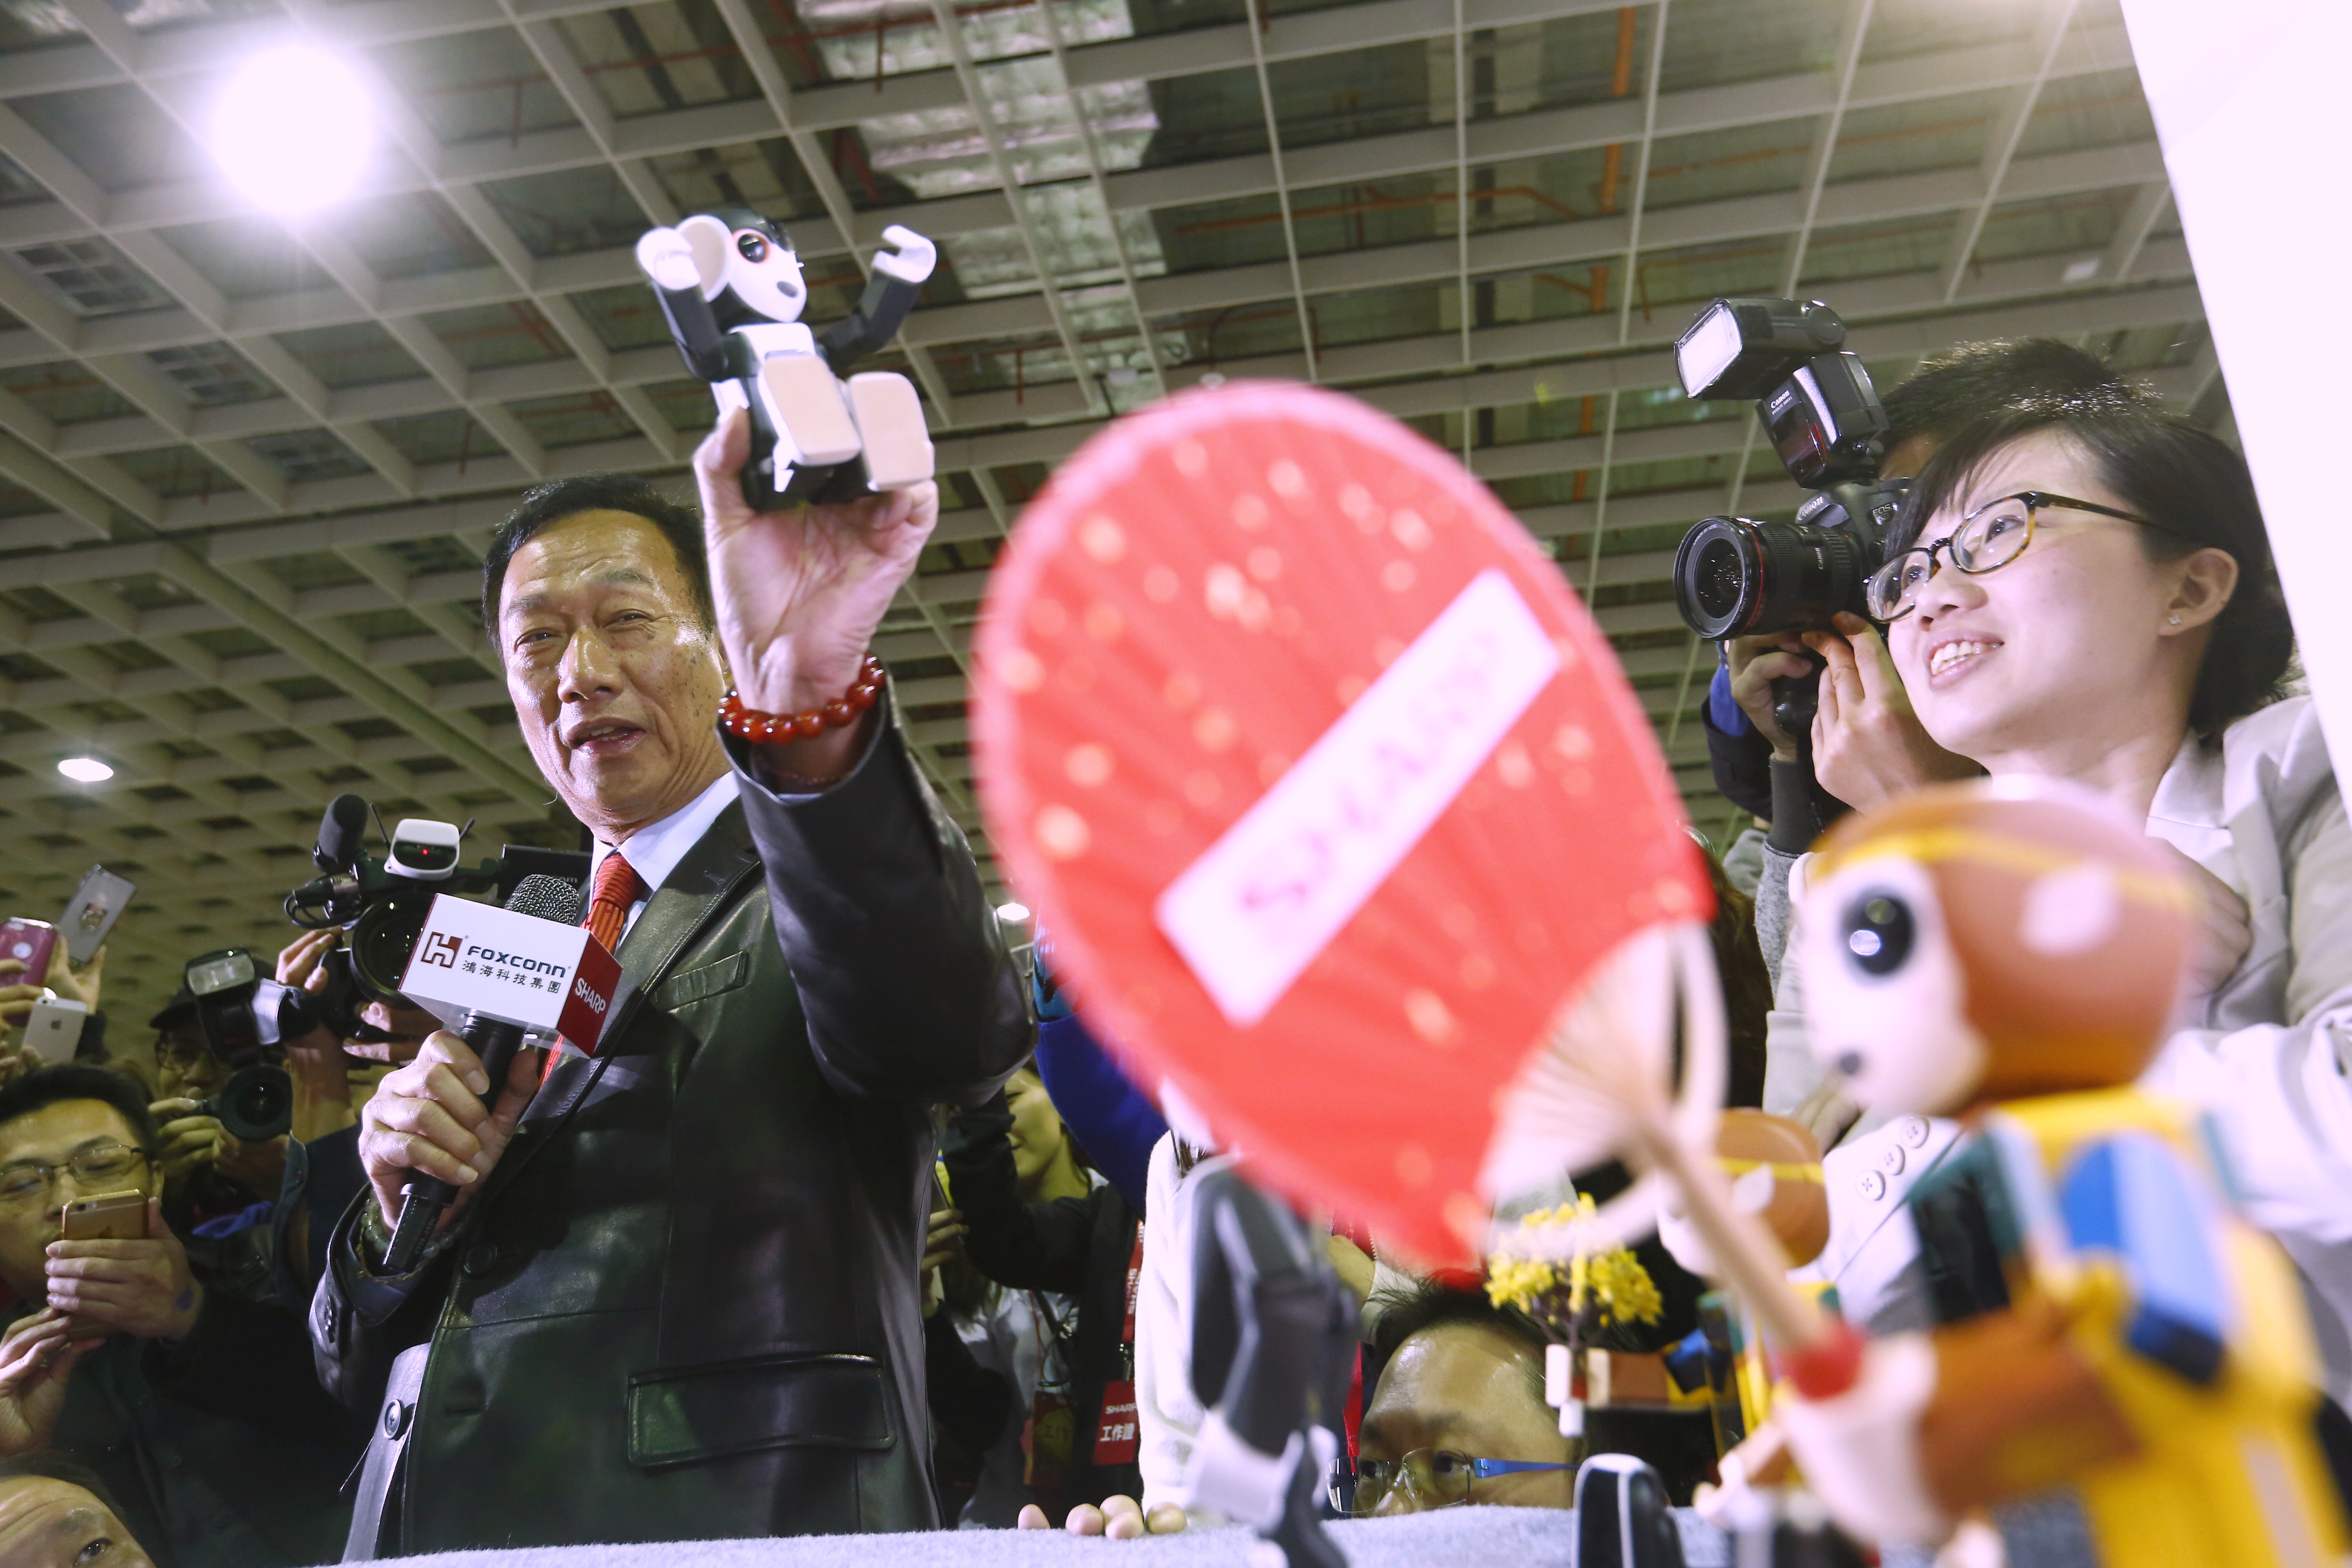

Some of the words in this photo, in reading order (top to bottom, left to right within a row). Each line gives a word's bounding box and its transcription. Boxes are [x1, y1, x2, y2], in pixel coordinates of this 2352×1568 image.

[1770, 390, 1790, 409] Canon
[1873, 504, 1891, 516] EOS
[1814, 547, 1823, 570] Canon
[467, 945, 566, 978] FOXCONN
[462, 960, 561, 994] 鴻海科技集團
[574, 977, 606, 1014] SHARP
